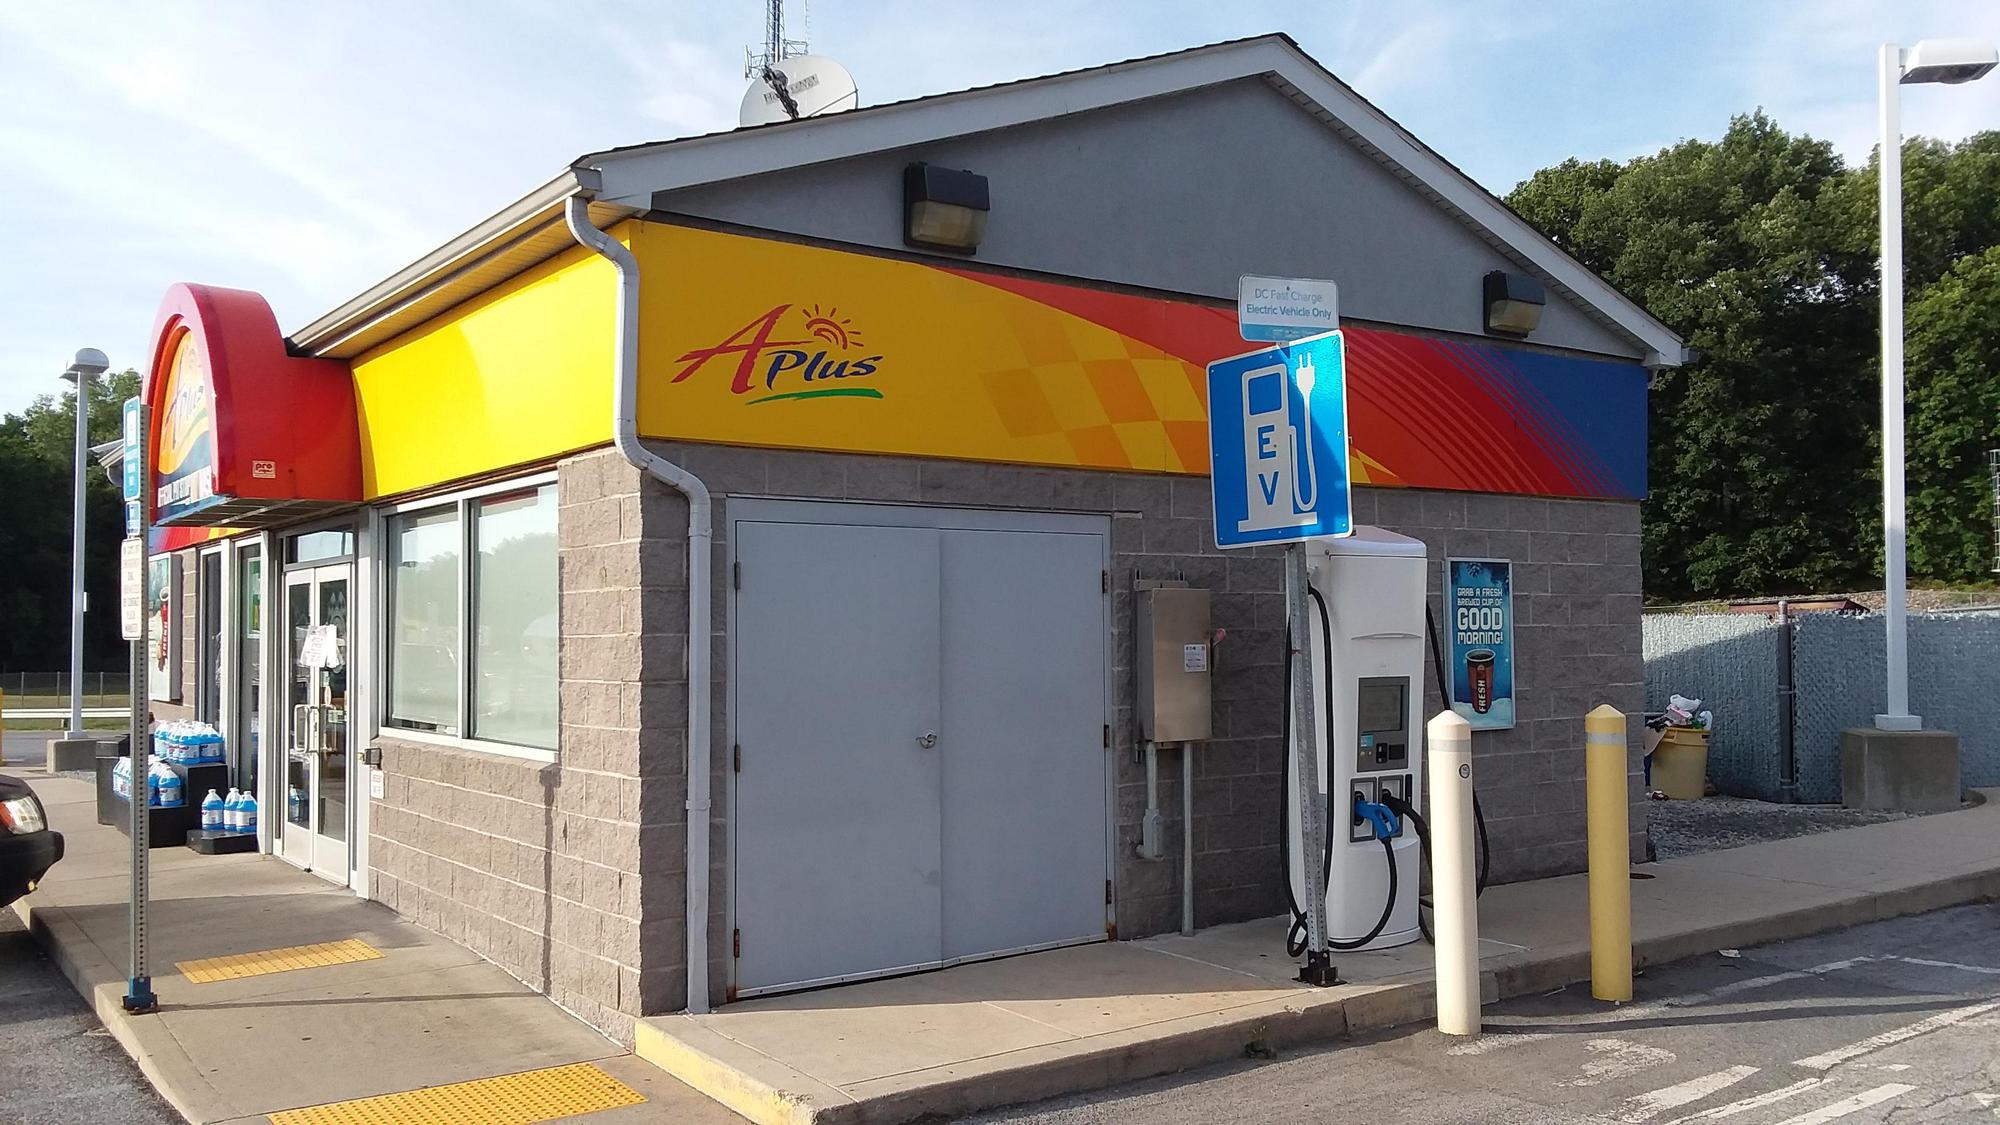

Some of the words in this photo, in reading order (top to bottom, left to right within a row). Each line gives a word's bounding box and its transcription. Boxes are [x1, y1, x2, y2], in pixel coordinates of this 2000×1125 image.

[1254, 288, 1269, 300] DC
[1290, 291, 1323, 305] Charge
[1246, 303, 1278, 316] Electric
[1279, 305, 1311, 317] Vehicle
[1312, 307, 1332, 320] Only
[1457, 587, 1474, 597] GRAB
[1475, 587, 1481, 597] A
[1482, 588, 1503, 597] FRESH
[1457, 598, 1480, 606] BREWED
[1481, 598, 1494, 606] CUP
[1495, 598, 1503, 606] OF
[1457, 607, 1503, 630] GOOD
[1457, 631, 1504, 645] MORNING!
[1477, 680, 1487, 712] FRESH
